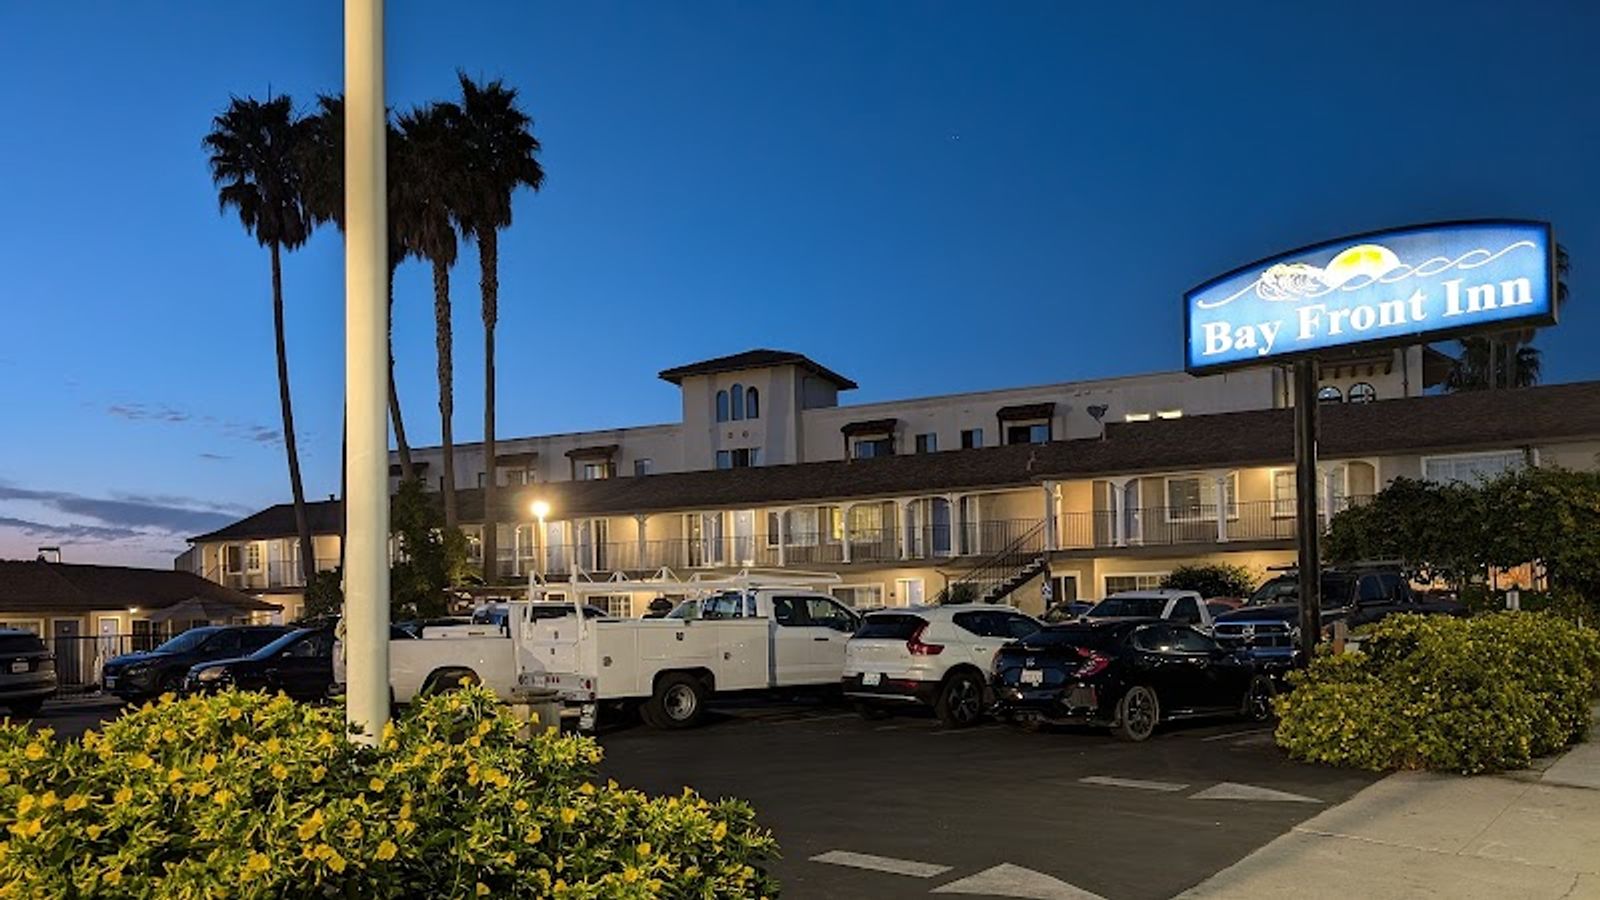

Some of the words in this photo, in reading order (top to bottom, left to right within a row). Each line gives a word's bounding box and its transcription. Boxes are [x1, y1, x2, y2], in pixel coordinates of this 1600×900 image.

[1201, 320, 1281, 356] Bay
[1295, 289, 1428, 341] Front
[1442, 277, 1533, 317] Inn
